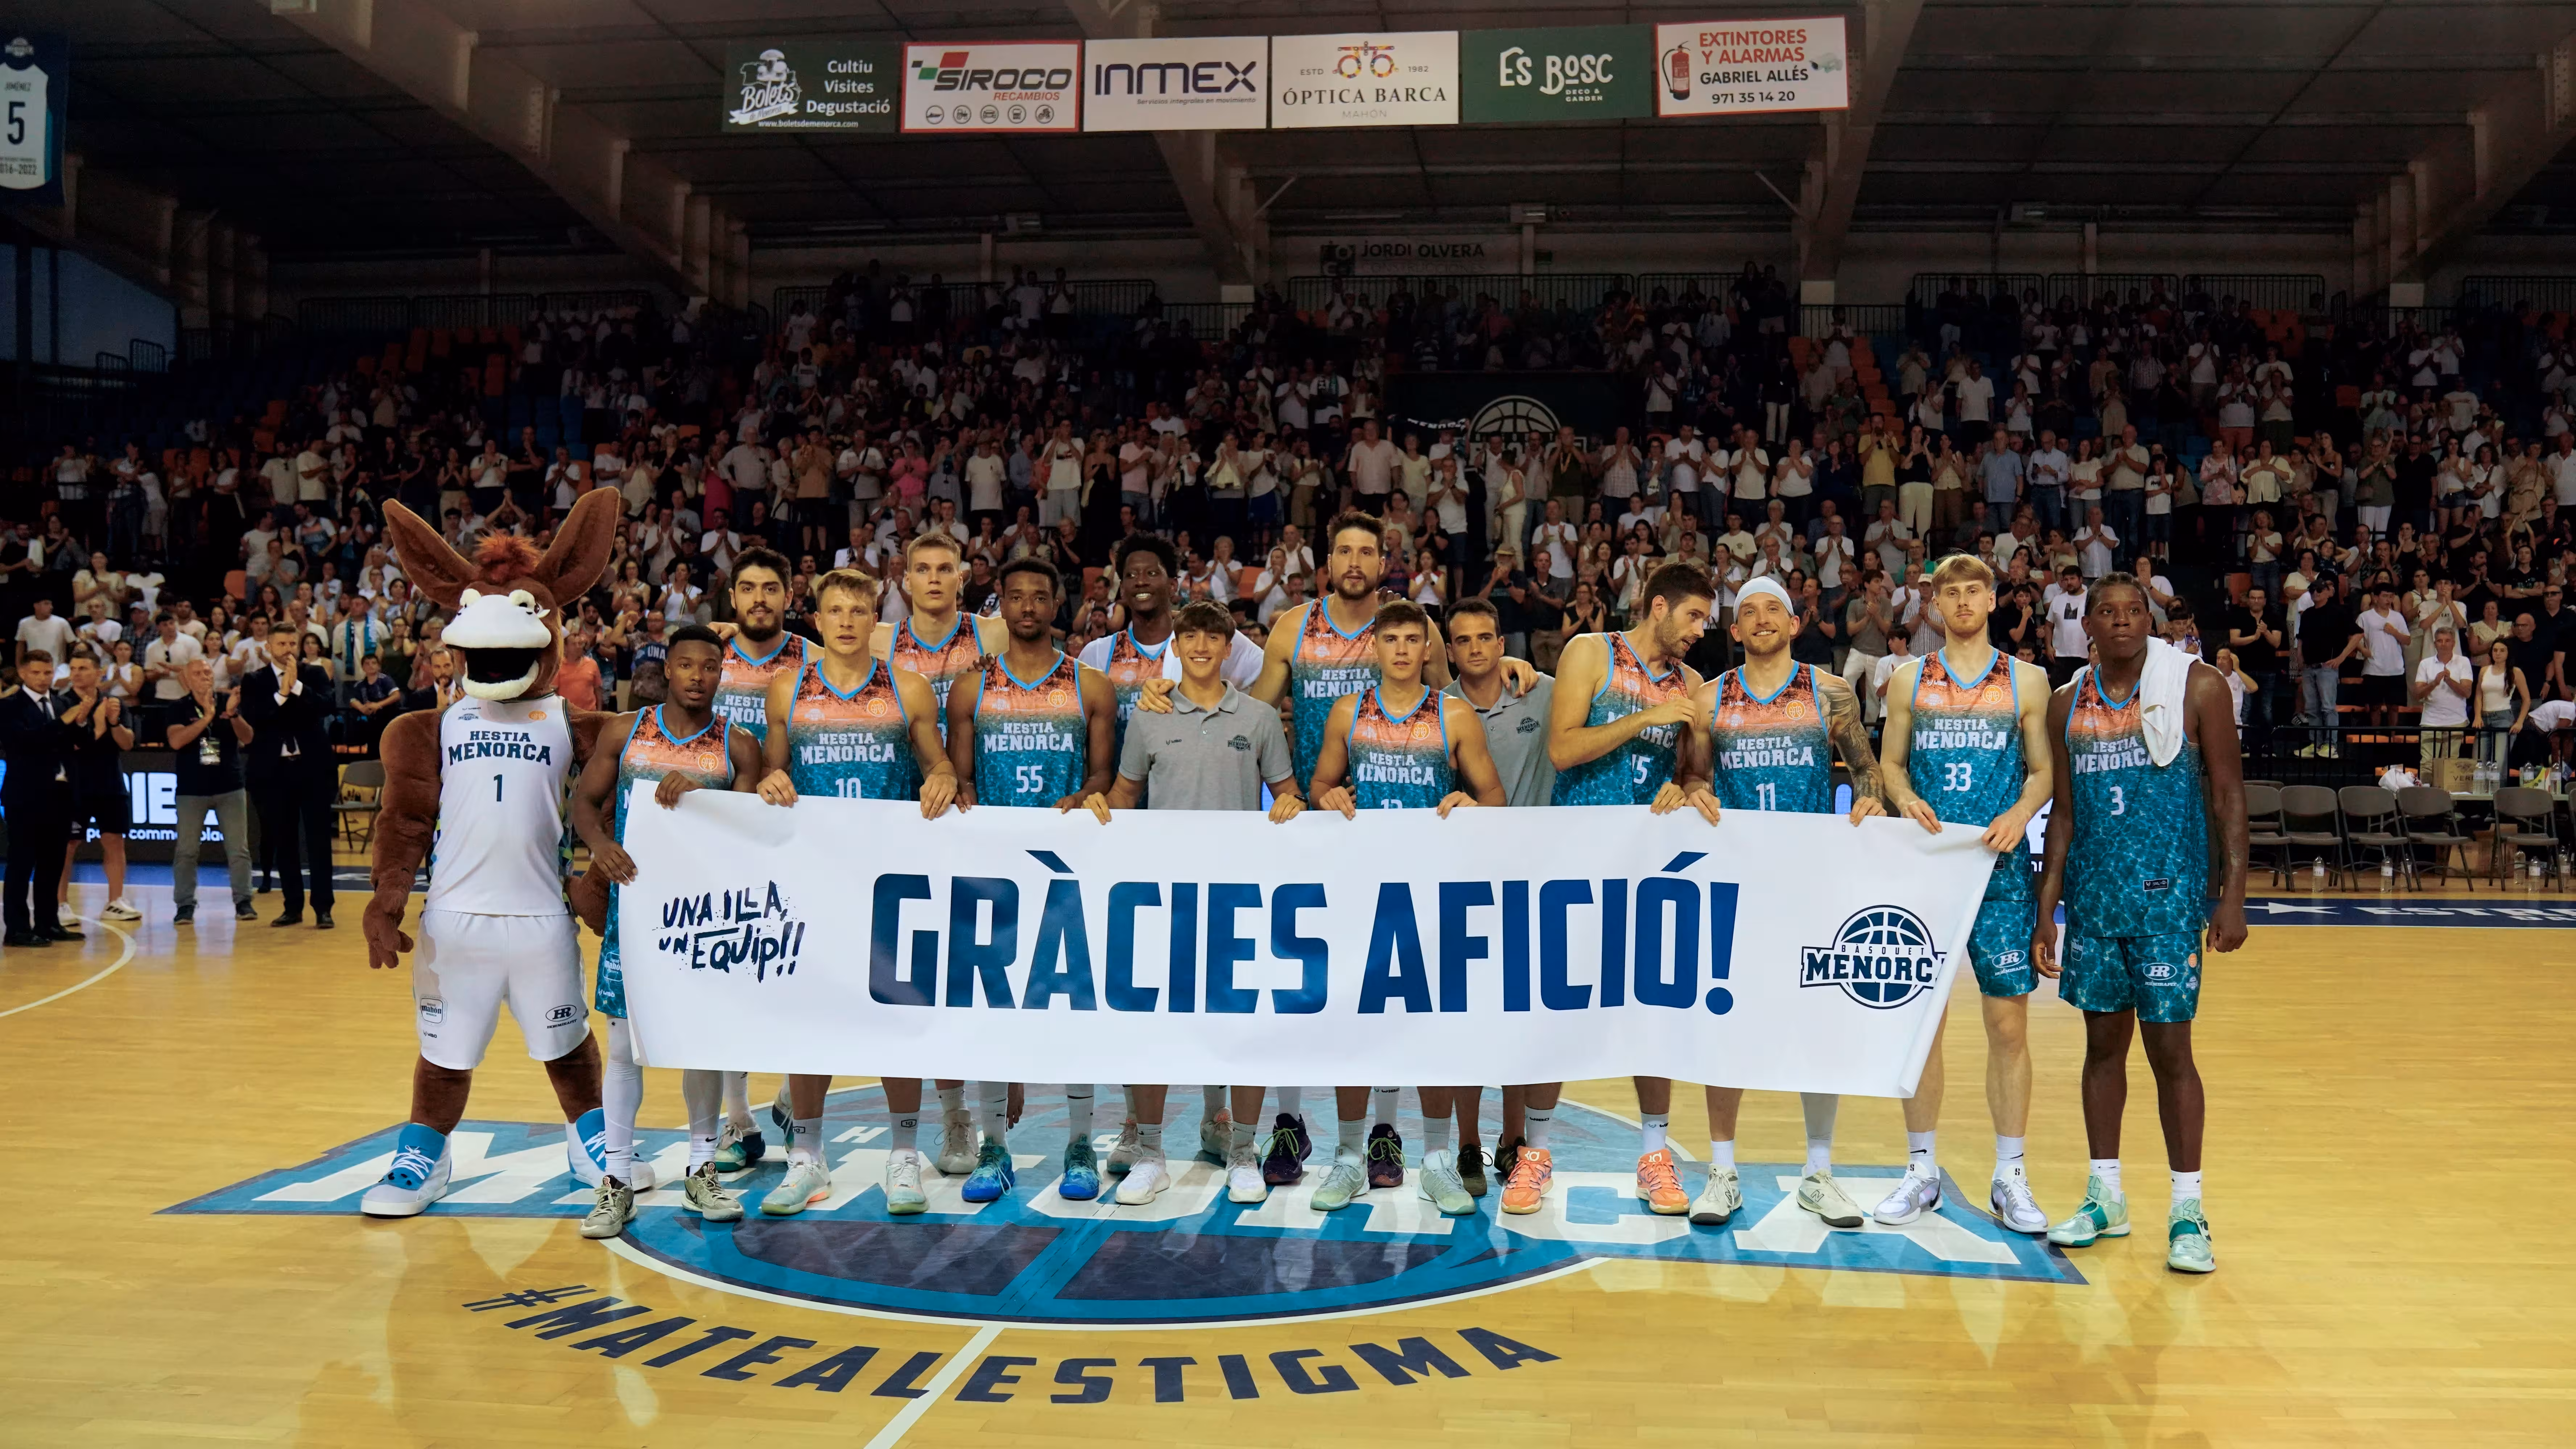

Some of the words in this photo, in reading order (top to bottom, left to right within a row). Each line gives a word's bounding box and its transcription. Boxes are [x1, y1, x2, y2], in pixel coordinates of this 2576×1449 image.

[1700, 29, 1807, 47] EXTINTORES
[1702, 50, 1713, 64] Y
[1719, 47, 1805, 64] ALARMAS
[827, 59, 873, 74] Cultiu
[1700, 71, 1762, 84] GABRIEL
[1767, 65, 1808, 82] ALLÉS
[824, 79, 874, 93] Visites
[934, 69, 1072, 91] SIROCO
[741, 81, 795, 113] Bolets
[994, 92, 1060, 101] RECAMBIOS
[1283, 88, 1365, 105] ÓPTICA
[1375, 87, 1447, 102] BARCA
[1712, 94, 1734, 104] 971
[1739, 92, 1755, 103] 35
[1759, 92, 1774, 102] 14
[1779, 91, 1795, 102] 20
[806, 99, 890, 116] Degustació
[8, 102, 25, 145] 5
[1418, 243, 1485, 258] OLVERA
[1321, 668, 1371, 681] HESTIA
[1304, 678, 1382, 698] MENORC
[724, 695, 766, 708] HESTI
[1003, 722, 1054, 734] HESTIA
[1934, 718, 1989, 731] HESTIA
[470, 731, 531, 742] HESTIA
[819, 732, 875, 745] HESTIA
[983, 733, 1074, 754] MENORCA
[1736, 736, 1793, 750] HESTIA
[1915, 730, 2007, 751] MENORCA
[2093, 736, 2138, 753] HESTIA
[449, 743, 551, 766] MENORCA
[800, 743, 895, 765] MENORCA
[1369, 752, 1416, 766] HESTIA
[1719, 746, 1814, 771] MENORCA
[2075, 748, 2153, 775] MENORC
[1016, 765, 1043, 793] 55
[1357, 763, 1435, 787] MENORCA
[1943, 762, 1972, 791] 33
[494, 774, 502, 802] 1
[835, 777, 862, 798] 10
[1755, 782, 1776, 810] 11
[2109, 786, 2125, 816] 3
[662, 892, 713, 929] UNA
[722, 880, 789, 924] ILLA,
[869, 850, 1328, 1014] GRÀCIES
[1357, 851, 1739, 1015] AFICIÓ!
[1841, 943, 1926, 956] BÀSQUET
[604, 959, 622, 971] mahó
[1805, 949, 1934, 983] MENORC
[1998, 952, 2019, 967] HR
[2148, 966, 2170, 978] HR
[552, 1007, 571, 1020] HR
[462, 1284, 1562, 1404] #MATEALESTIGMA
